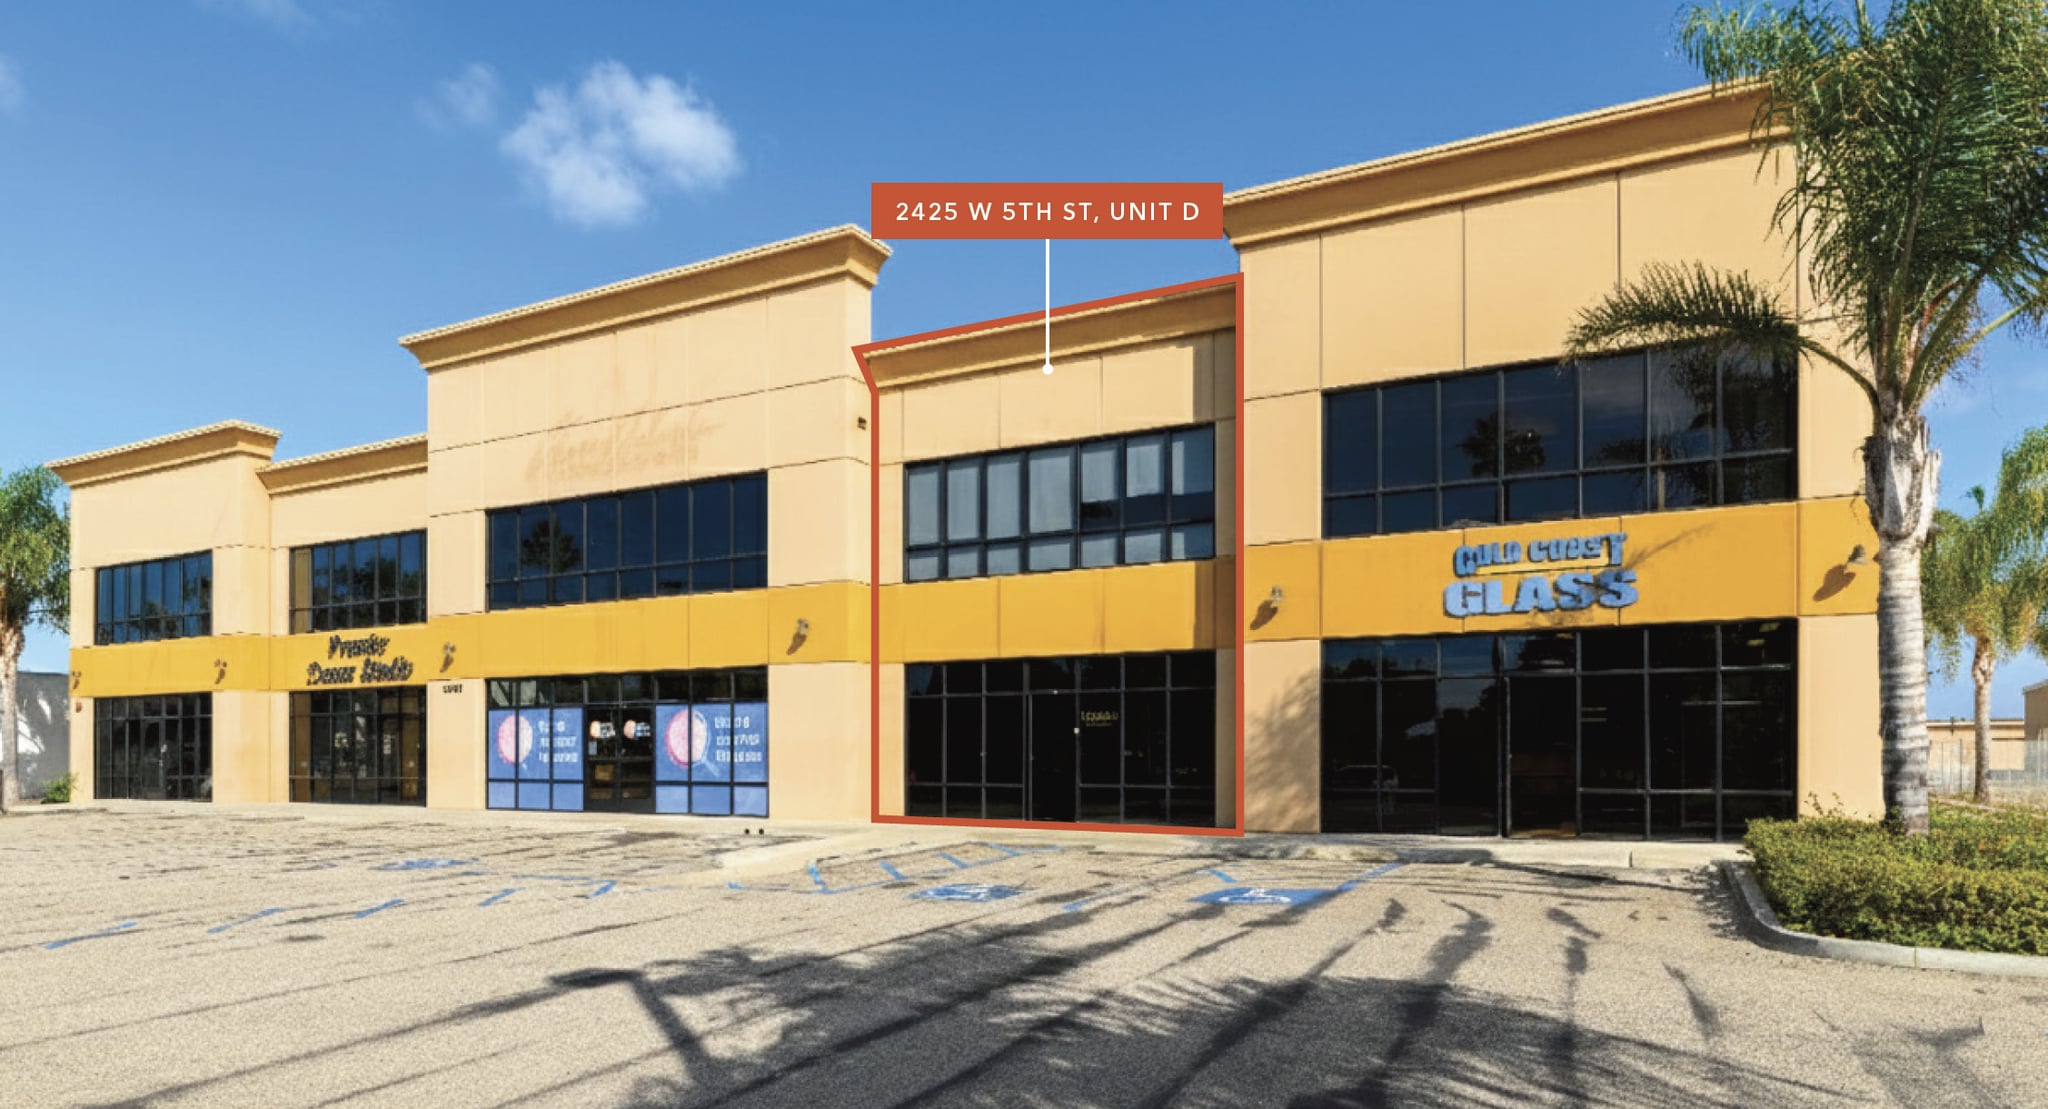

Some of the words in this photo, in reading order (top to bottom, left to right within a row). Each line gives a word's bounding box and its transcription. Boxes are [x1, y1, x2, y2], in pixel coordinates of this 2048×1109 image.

[1454, 541, 1521, 577] GOLD
[1527, 533, 1628, 567] COAST
[1443, 569, 1639, 618] GLASS
